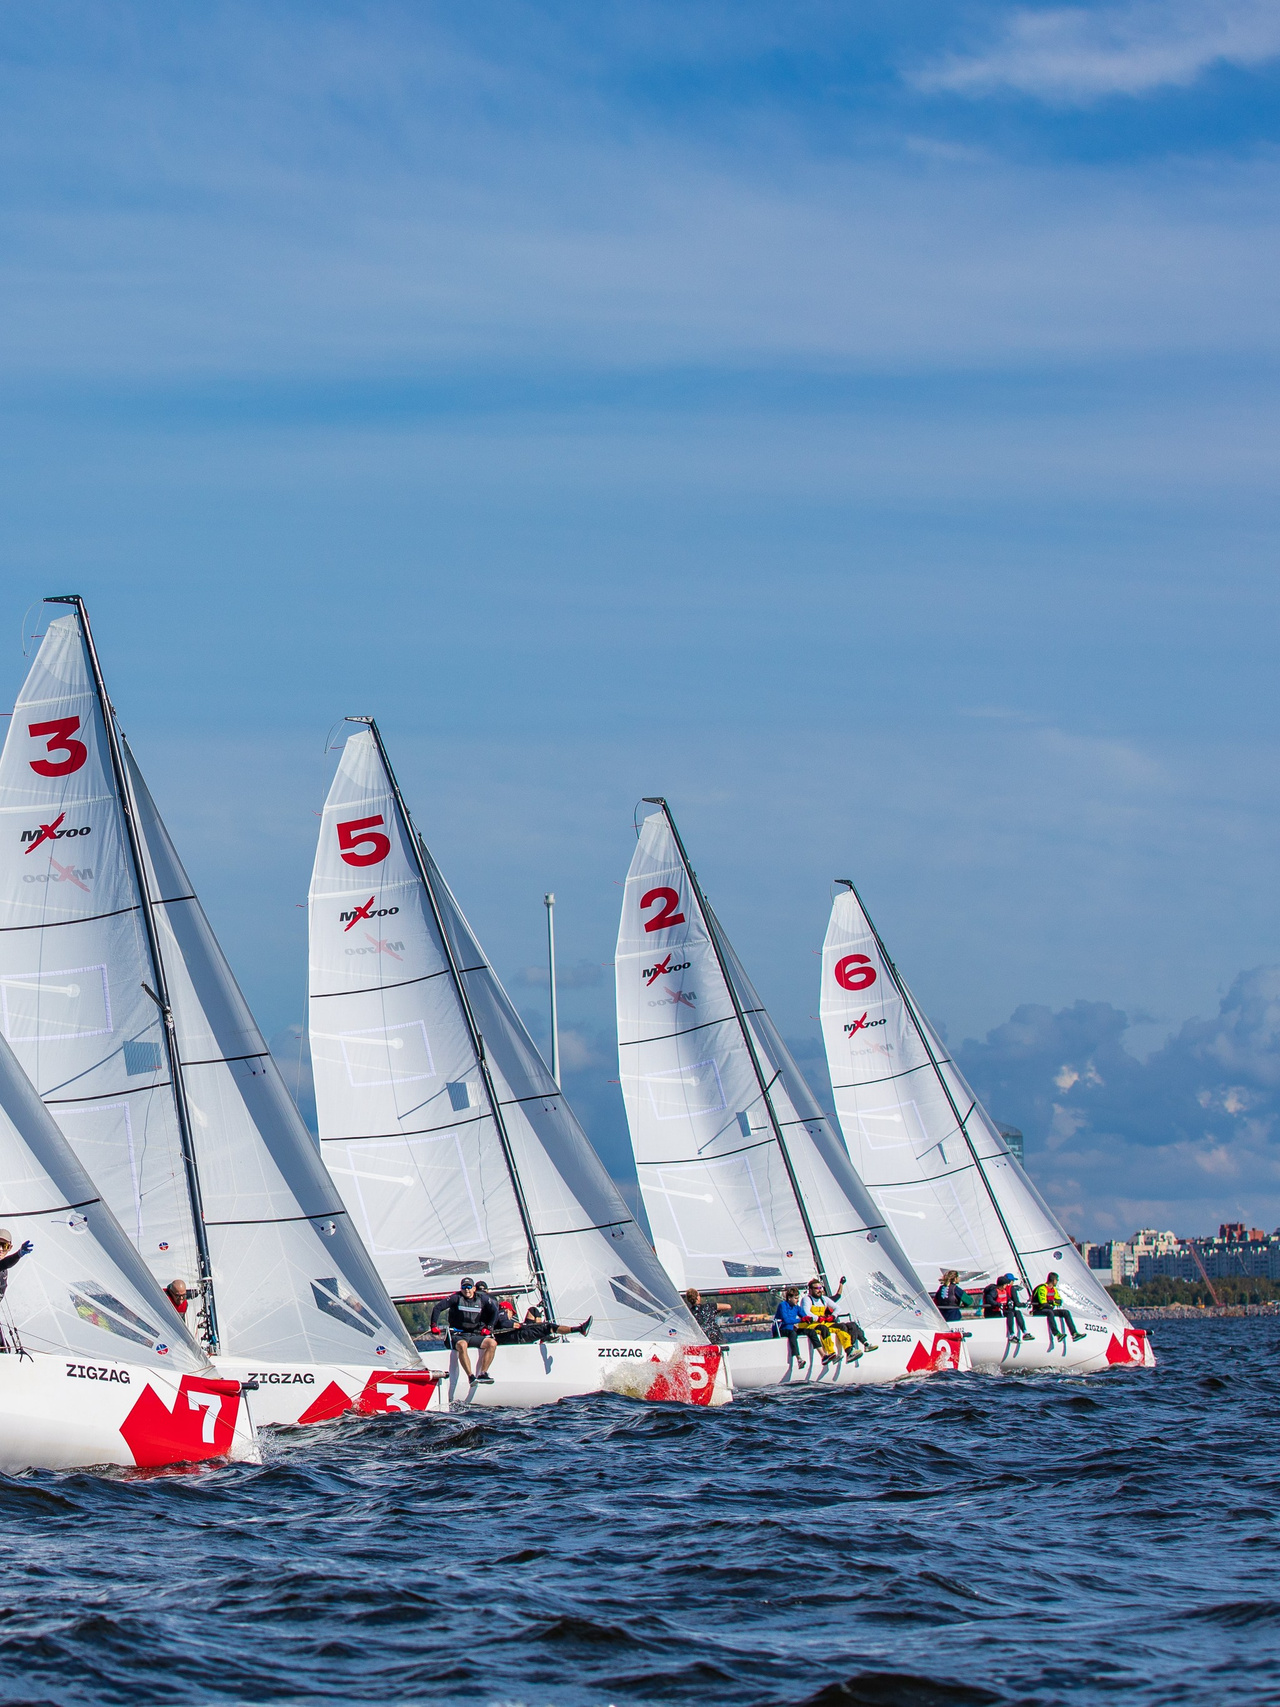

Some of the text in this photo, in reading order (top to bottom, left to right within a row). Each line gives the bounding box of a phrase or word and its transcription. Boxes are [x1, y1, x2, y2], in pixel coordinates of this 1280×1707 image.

[28, 716, 87, 777] 3
[20, 812, 92, 854] MX700
[336, 814, 391, 868] 5
[339, 895, 400, 932] MX700
[639, 887, 686, 933] 2
[642, 953, 692, 987] MX700
[834, 953, 877, 991] 6
[843, 1012, 887, 1039] MX700
[881, 1334, 912, 1343] ZIGZAG
[1084, 1323, 1108, 1334] ZIGZAG
[597, 1348, 643, 1358] ZIGZAG
[936, 1339, 955, 1370] 2
[1126, 1335, 1143, 1361] 6
[66, 1363, 131, 1384] ZIGZAG
[247, 1372, 315, 1385] ZIGZAG
[685, 1354, 709, 1390] 5
[376, 1382, 412, 1412] 3
[186, 1390, 223, 1444] 7
